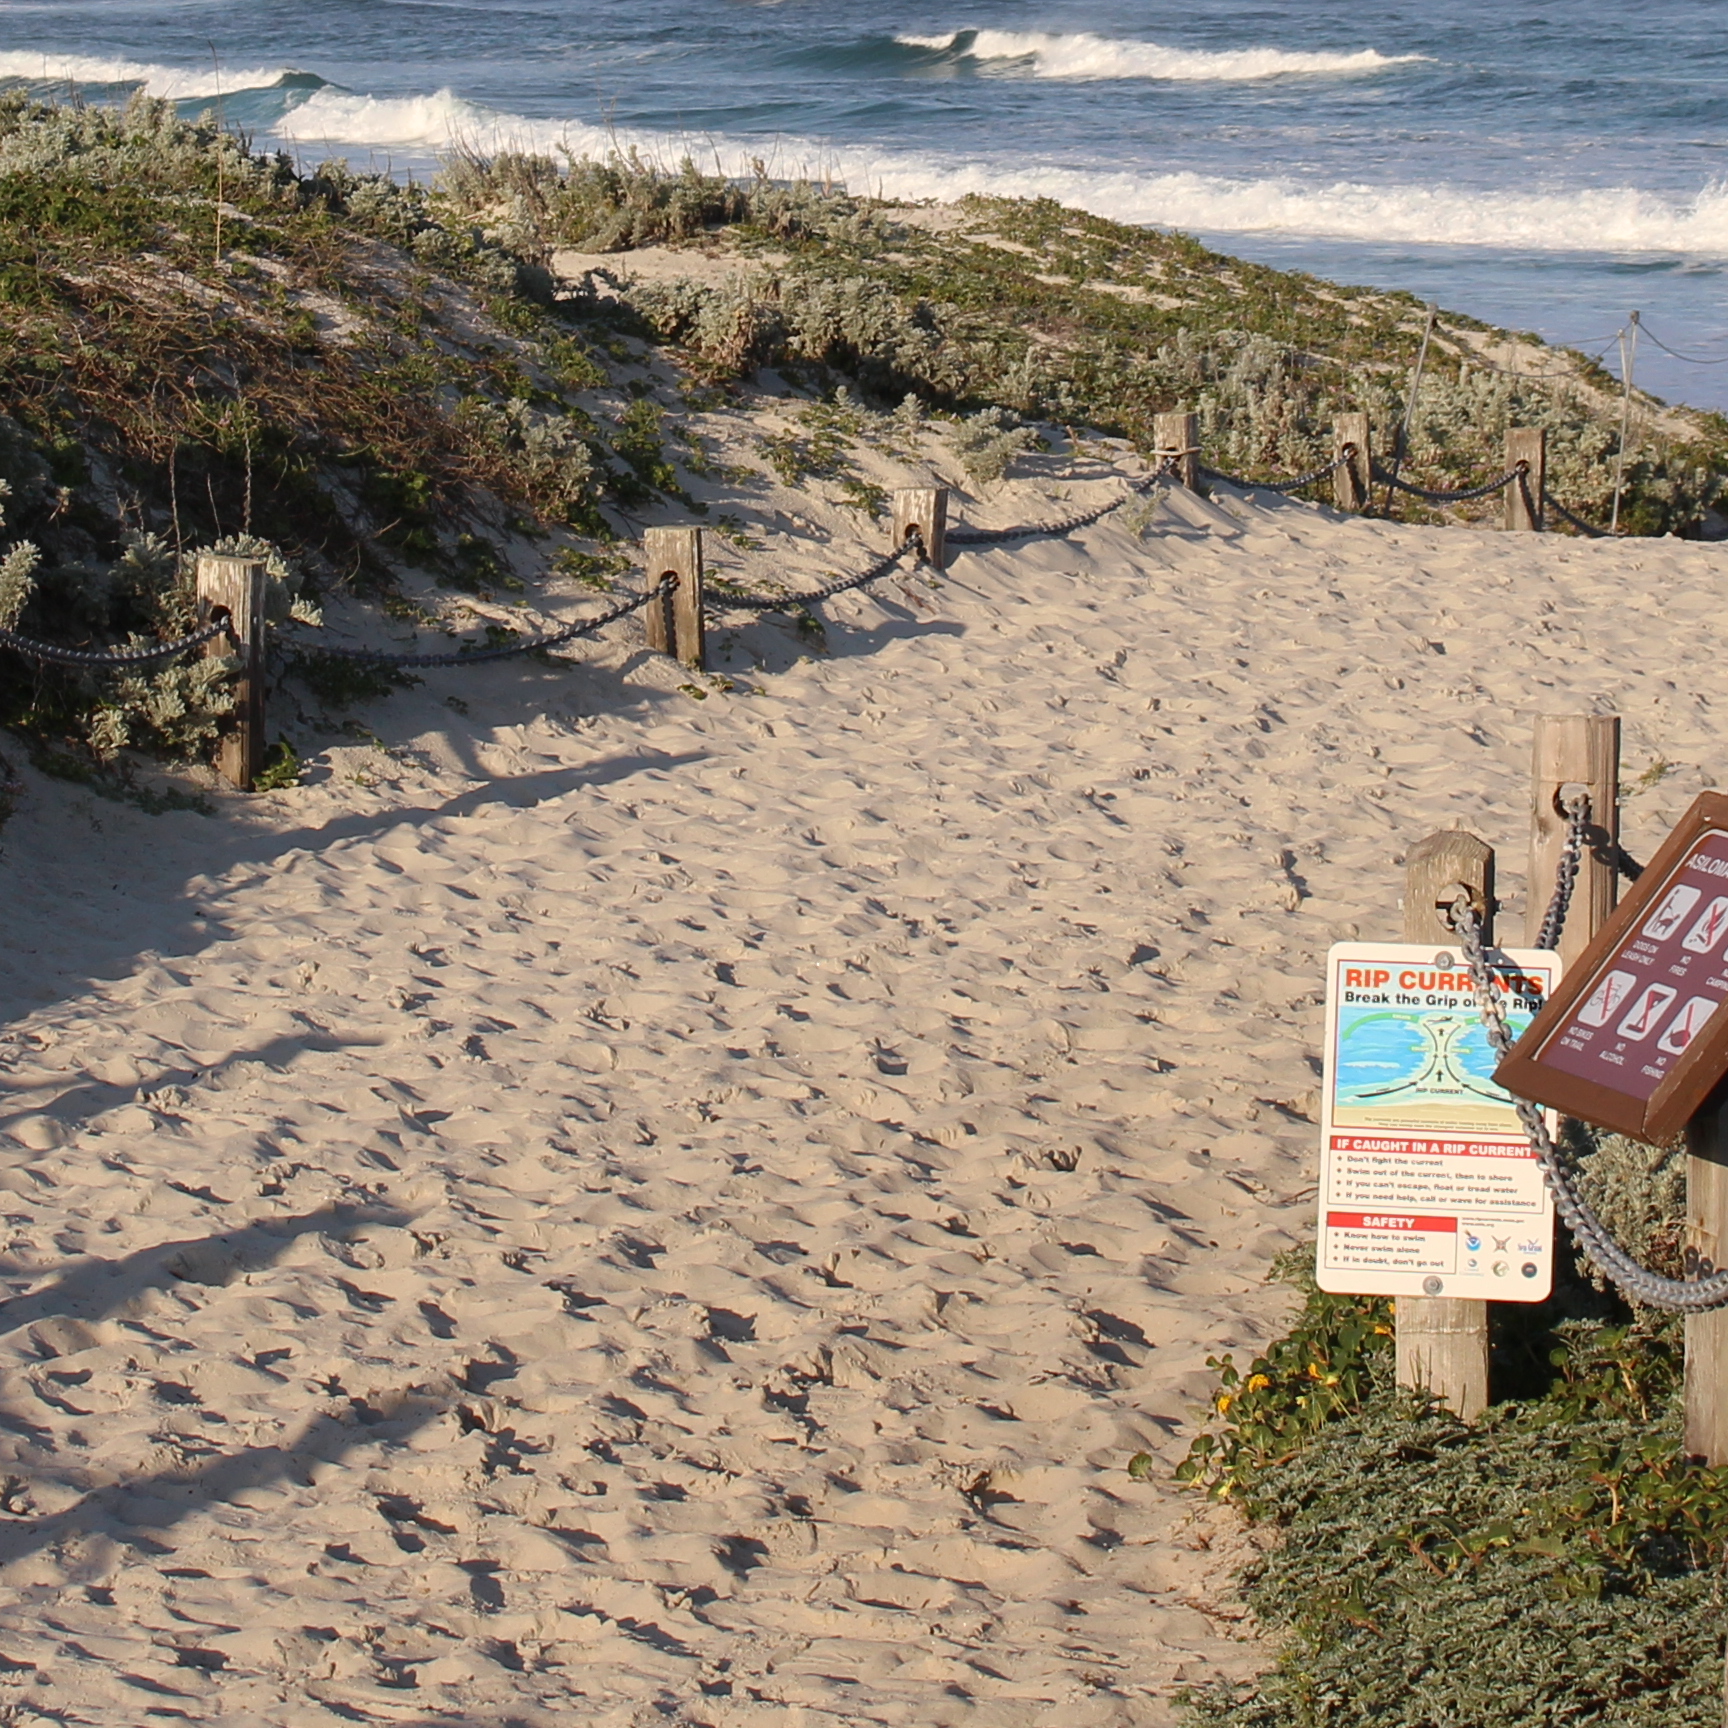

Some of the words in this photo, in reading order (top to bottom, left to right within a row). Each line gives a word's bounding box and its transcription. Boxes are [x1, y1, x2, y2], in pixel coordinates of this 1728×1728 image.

[1346, 969, 1390, 988] RIP
[1399, 970, 1543, 995] CURRNTS
[1345, 991, 1390, 1004] Break
[1395, 993, 1420, 1005] the
[1426, 994, 1458, 1009] Grip
[1513, 998, 1543, 1012] Rip!
[1337, 1139, 1350, 1149] IF
[1353, 1139, 1409, 1152] CAUGHT
[1412, 1142, 1427, 1152] IN
[1430, 1143, 1440, 1153] A
[1443, 1143, 1466, 1154] RIP
[1469, 1144, 1531, 1157] CURRENT
[1347, 1155, 1370, 1163] Don't
[1489, 1199, 1537, 1207] assistance
[1363, 1216, 1415, 1228] SAFETY
[1344, 1232, 1368, 1240] Know
